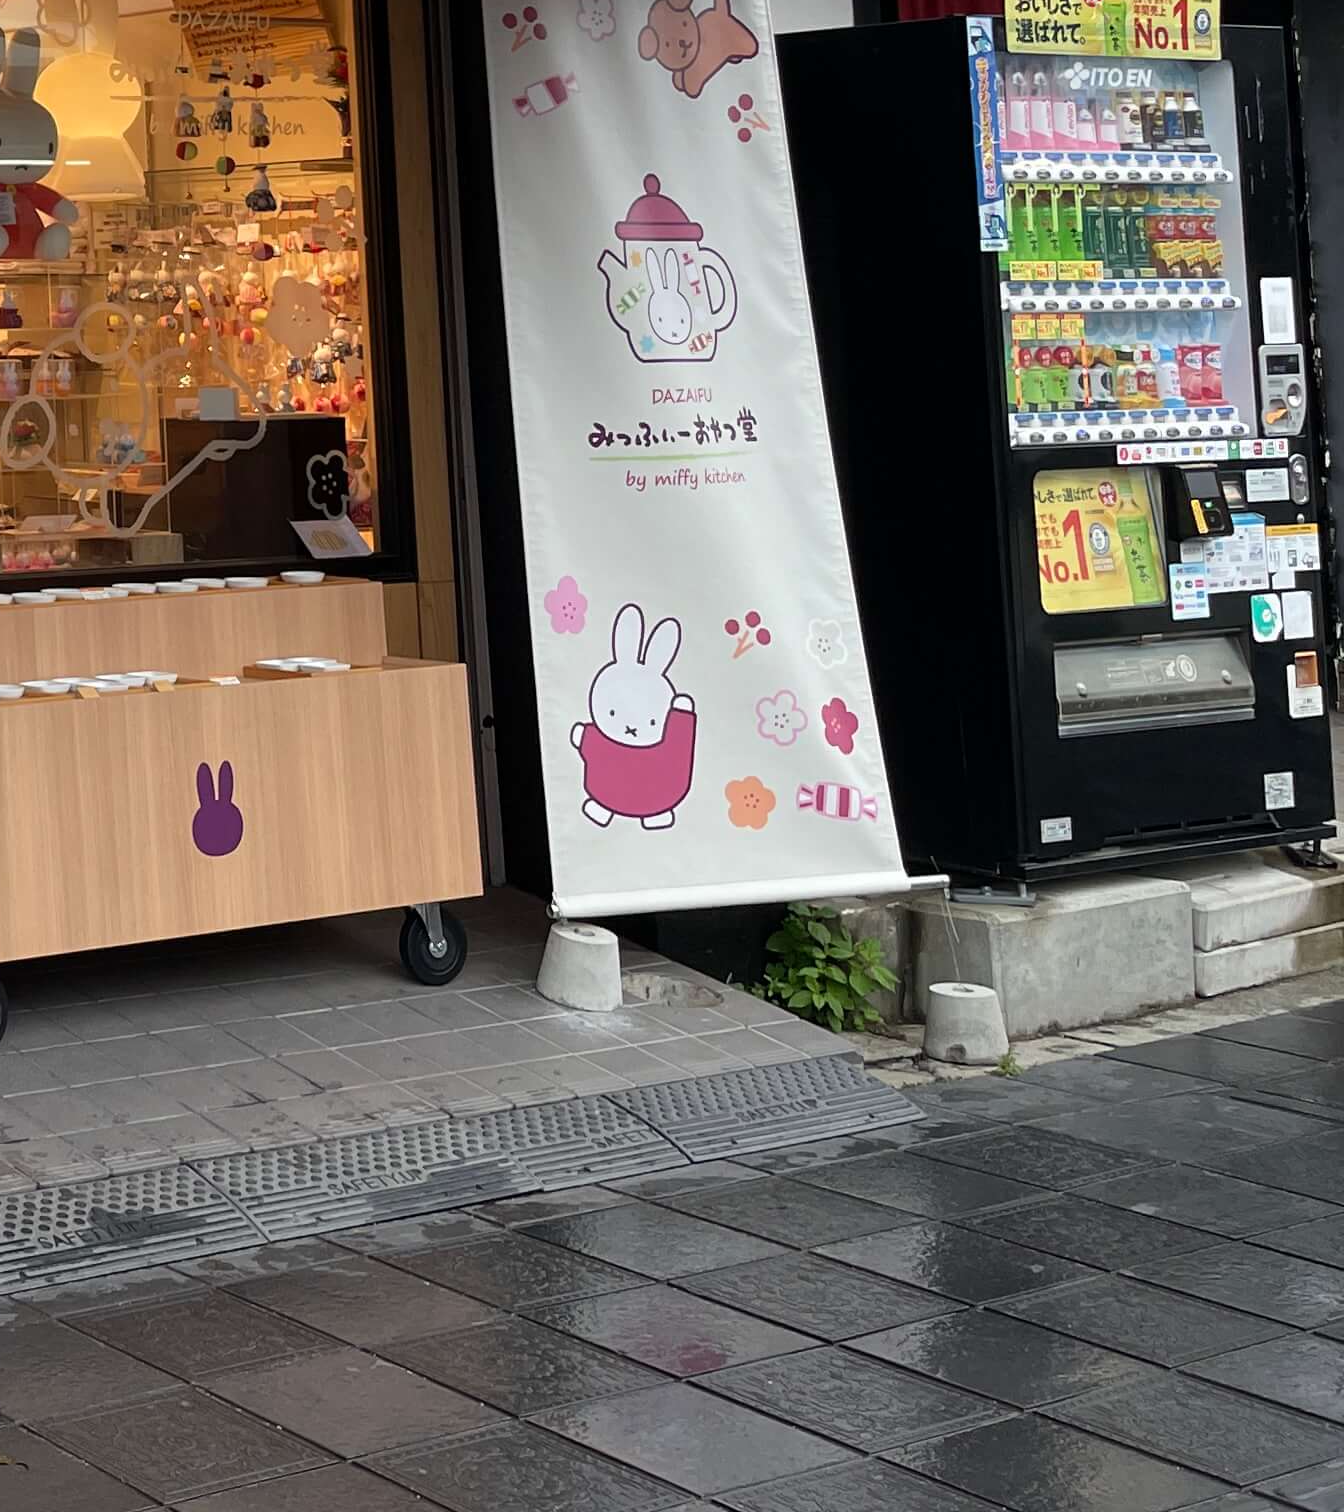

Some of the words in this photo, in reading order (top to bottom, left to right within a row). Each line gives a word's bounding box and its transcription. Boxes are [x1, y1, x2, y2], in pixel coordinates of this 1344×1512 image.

[177, 10, 271, 32] DAZAIFU
[1089, 67, 1126, 88] ITO
[1126, 68, 1153, 89] EN
[652, 388, 712, 405] DAZAIFU
[588, 406, 759, 448] みっふぃーおやつ堂
[625, 469, 646, 492] by
[655, 468, 699, 490] miffy
[704, 467, 746, 485] kitchen
